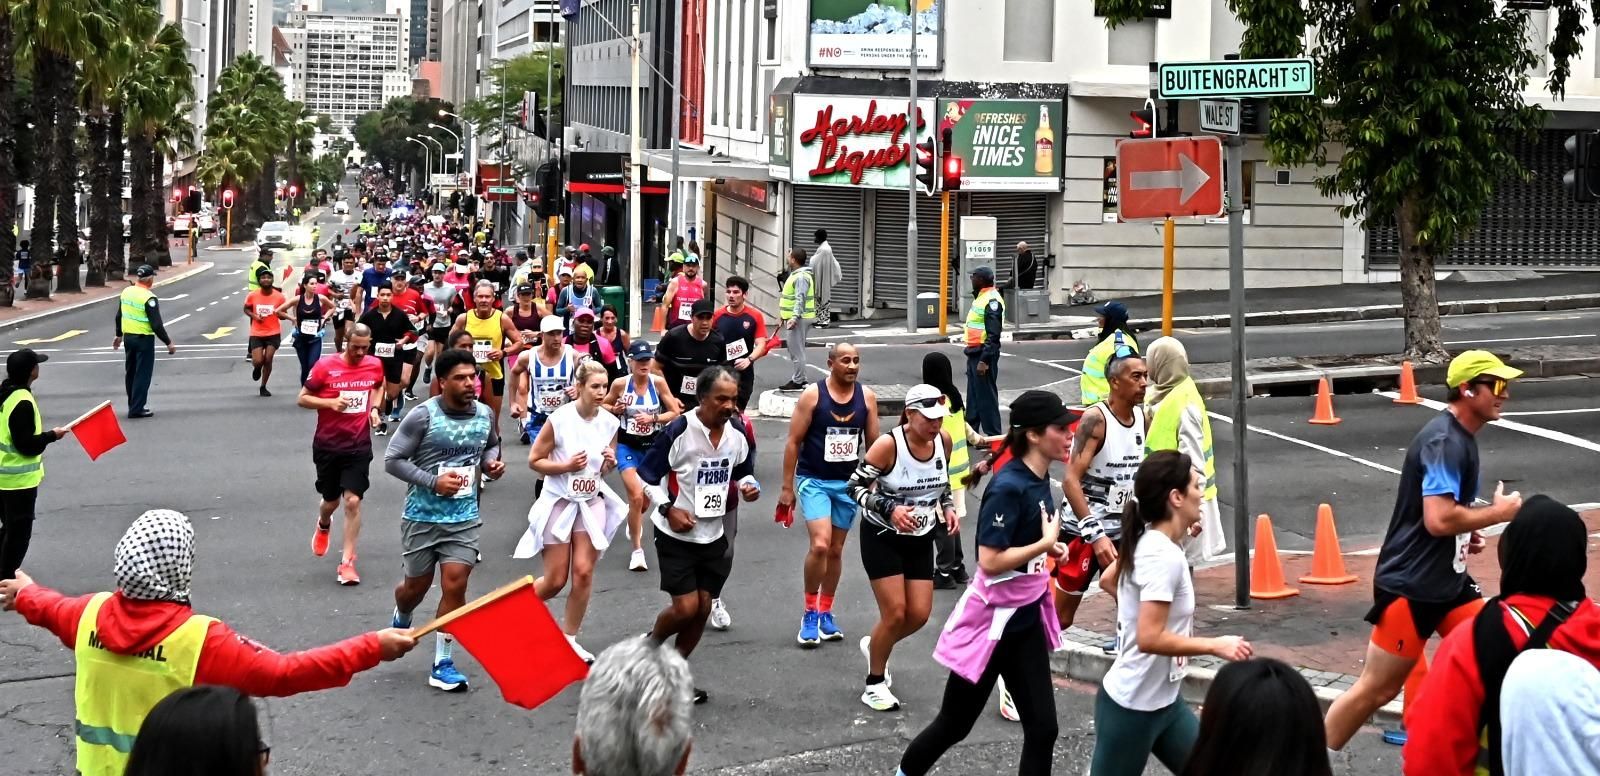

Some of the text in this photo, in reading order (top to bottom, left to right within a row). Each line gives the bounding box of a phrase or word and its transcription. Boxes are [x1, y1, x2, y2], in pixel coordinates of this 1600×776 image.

[1165, 67, 1307, 91] BUITENGRACHT ST
[974, 112, 1028, 124] REFRESHES
[1204, 104, 1234, 127] WALE ST
[972, 125, 1023, 145] iNICE
[972, 146, 1026, 167] TIMES
[727, 345, 744, 356] 5049
[685, 381, 695, 391] 63
[541, 397, 561, 407] 3565
[630, 422, 651, 434] 3566
[829, 442, 854, 455] 3530
[696, 468, 729, 485] P12886
[572, 479, 596, 493] 6008
[703, 495, 722, 509] 259
